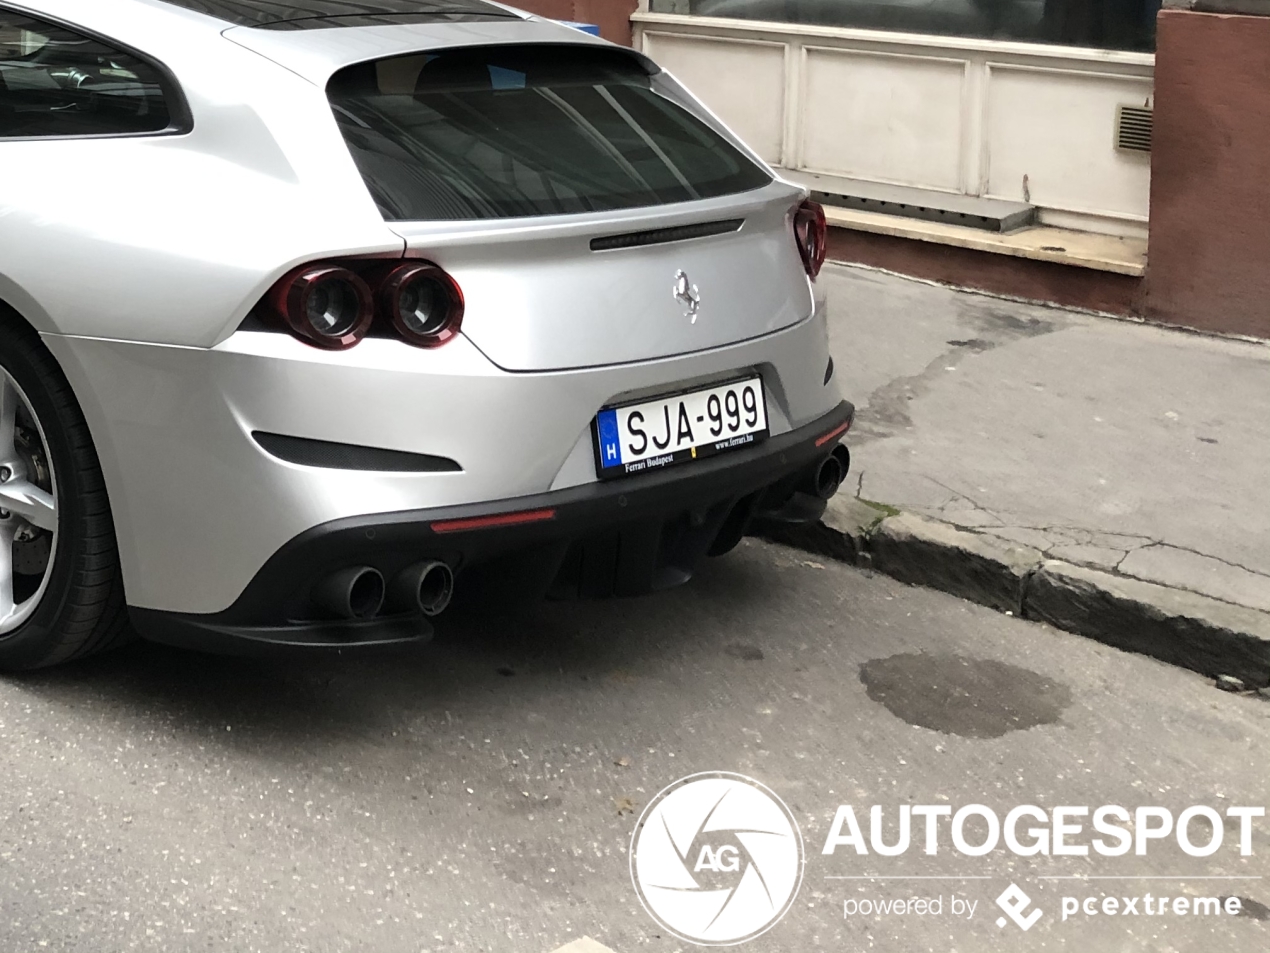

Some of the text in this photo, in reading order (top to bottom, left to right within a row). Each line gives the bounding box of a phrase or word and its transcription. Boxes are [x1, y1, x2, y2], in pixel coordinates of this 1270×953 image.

[626, 385, 758, 456] SJA-999
[714, 433, 754, 450] www.ferrari.hu
[606, 443, 617, 460] H
[624, 459, 646, 473] Ferrari
